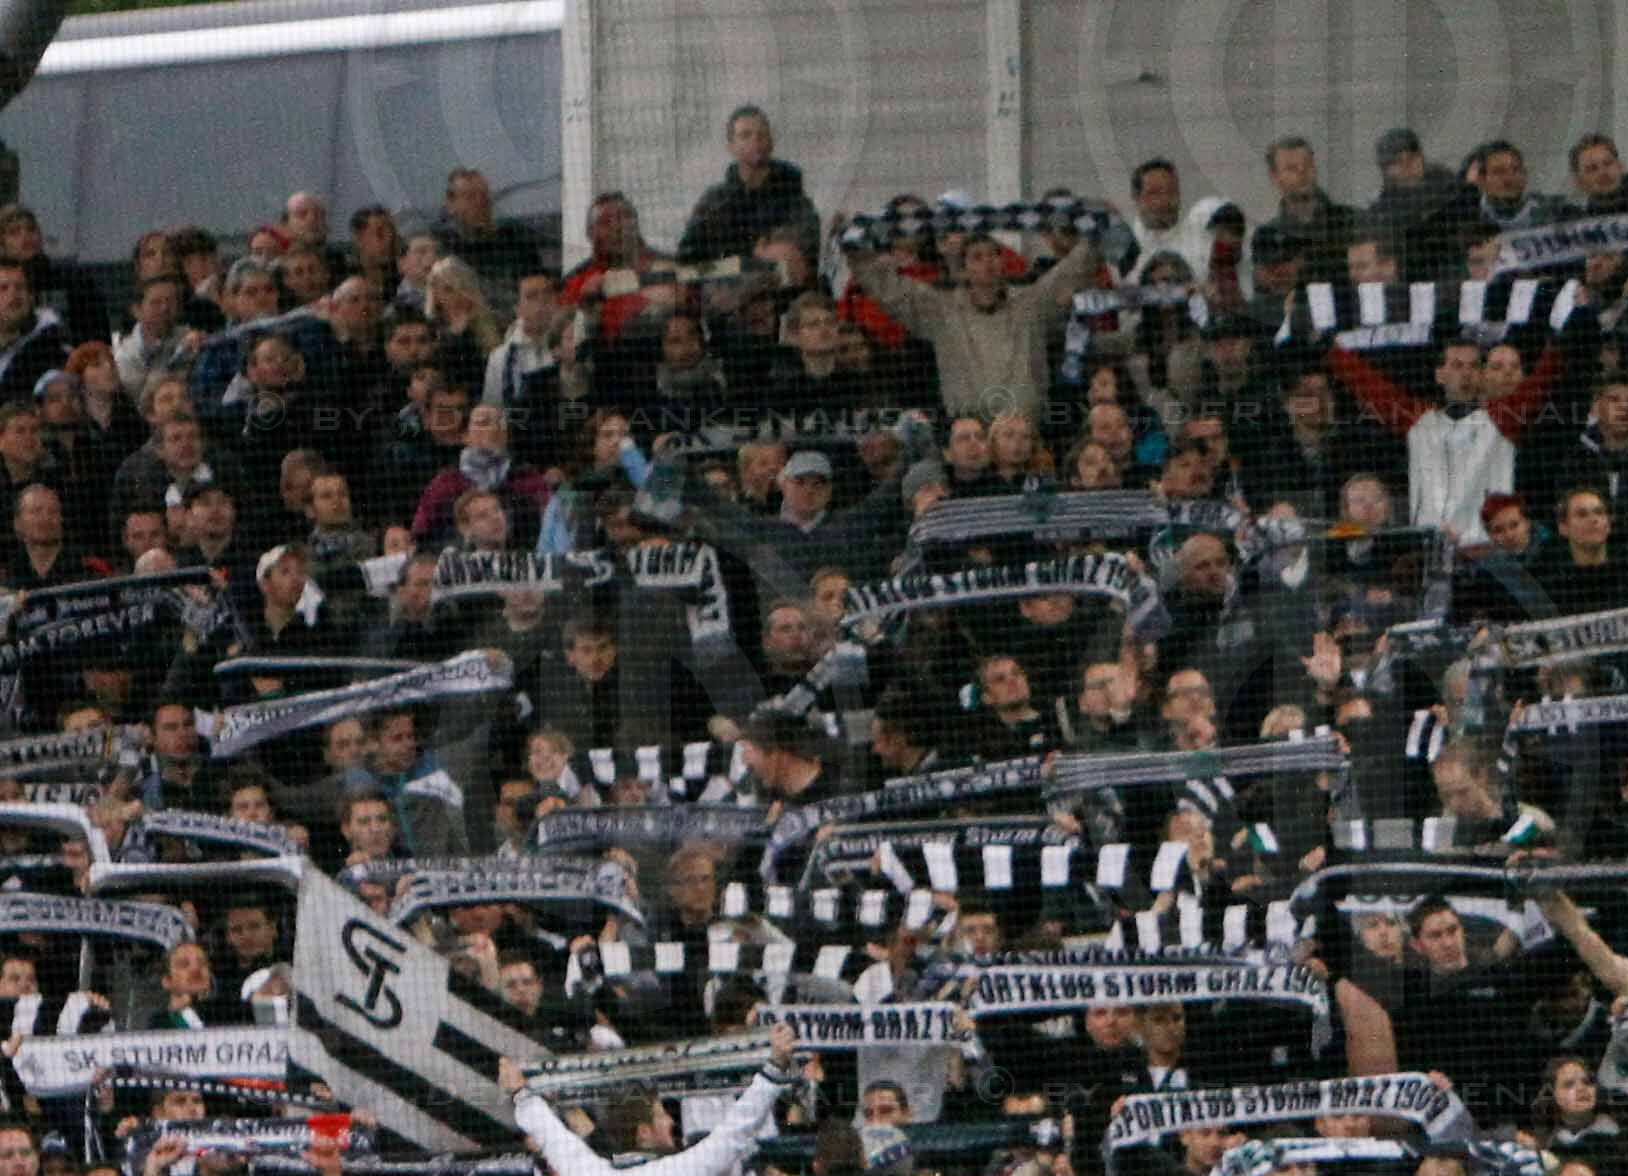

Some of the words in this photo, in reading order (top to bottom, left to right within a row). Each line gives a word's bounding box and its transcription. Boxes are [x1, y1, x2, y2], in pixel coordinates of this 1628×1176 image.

[64, 1048, 97, 1073] SK
[112, 1043, 207, 1072] STURM
[217, 1038, 291, 1065] GRAZ
